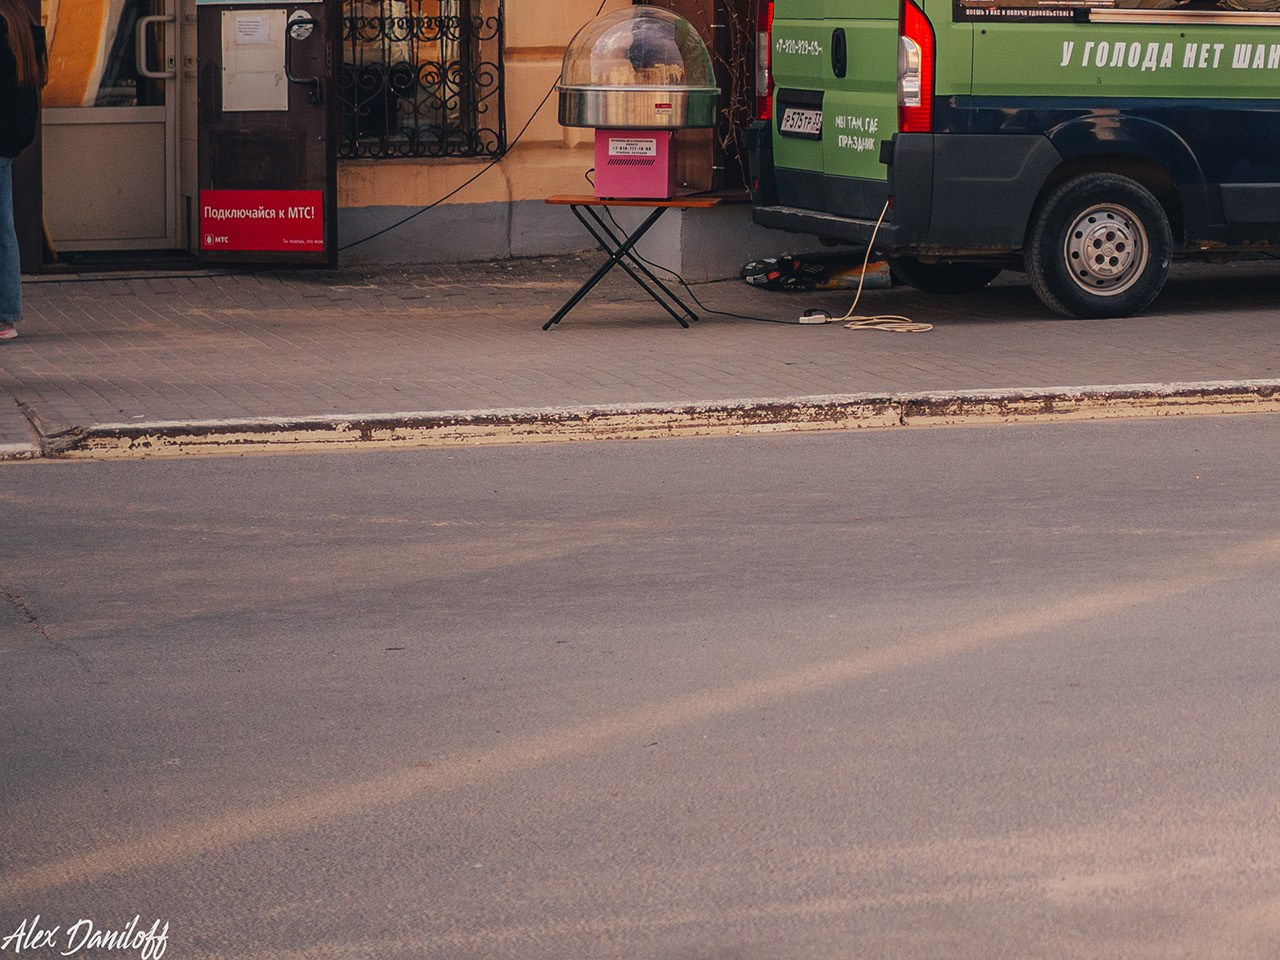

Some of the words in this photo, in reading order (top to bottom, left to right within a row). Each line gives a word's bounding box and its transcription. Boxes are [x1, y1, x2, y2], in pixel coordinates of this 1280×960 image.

[1029, 10, 1069, 18] УДОВОЛЬСТВИЕ
[1060, 41, 1074, 67] У
[1082, 41, 1173, 71] ГОЛОДА
[1183, 43, 1224, 68] НЕТ
[835, 115, 846, 128] МЫ
[847, 116, 863, 132] ТАМ,
[865, 117, 878, 133] ГДЕ
[838, 134, 875, 152] ПРАЗДНИК
[204, 206, 276, 220] Подключайся
[288, 207, 314, 219] МТС!
